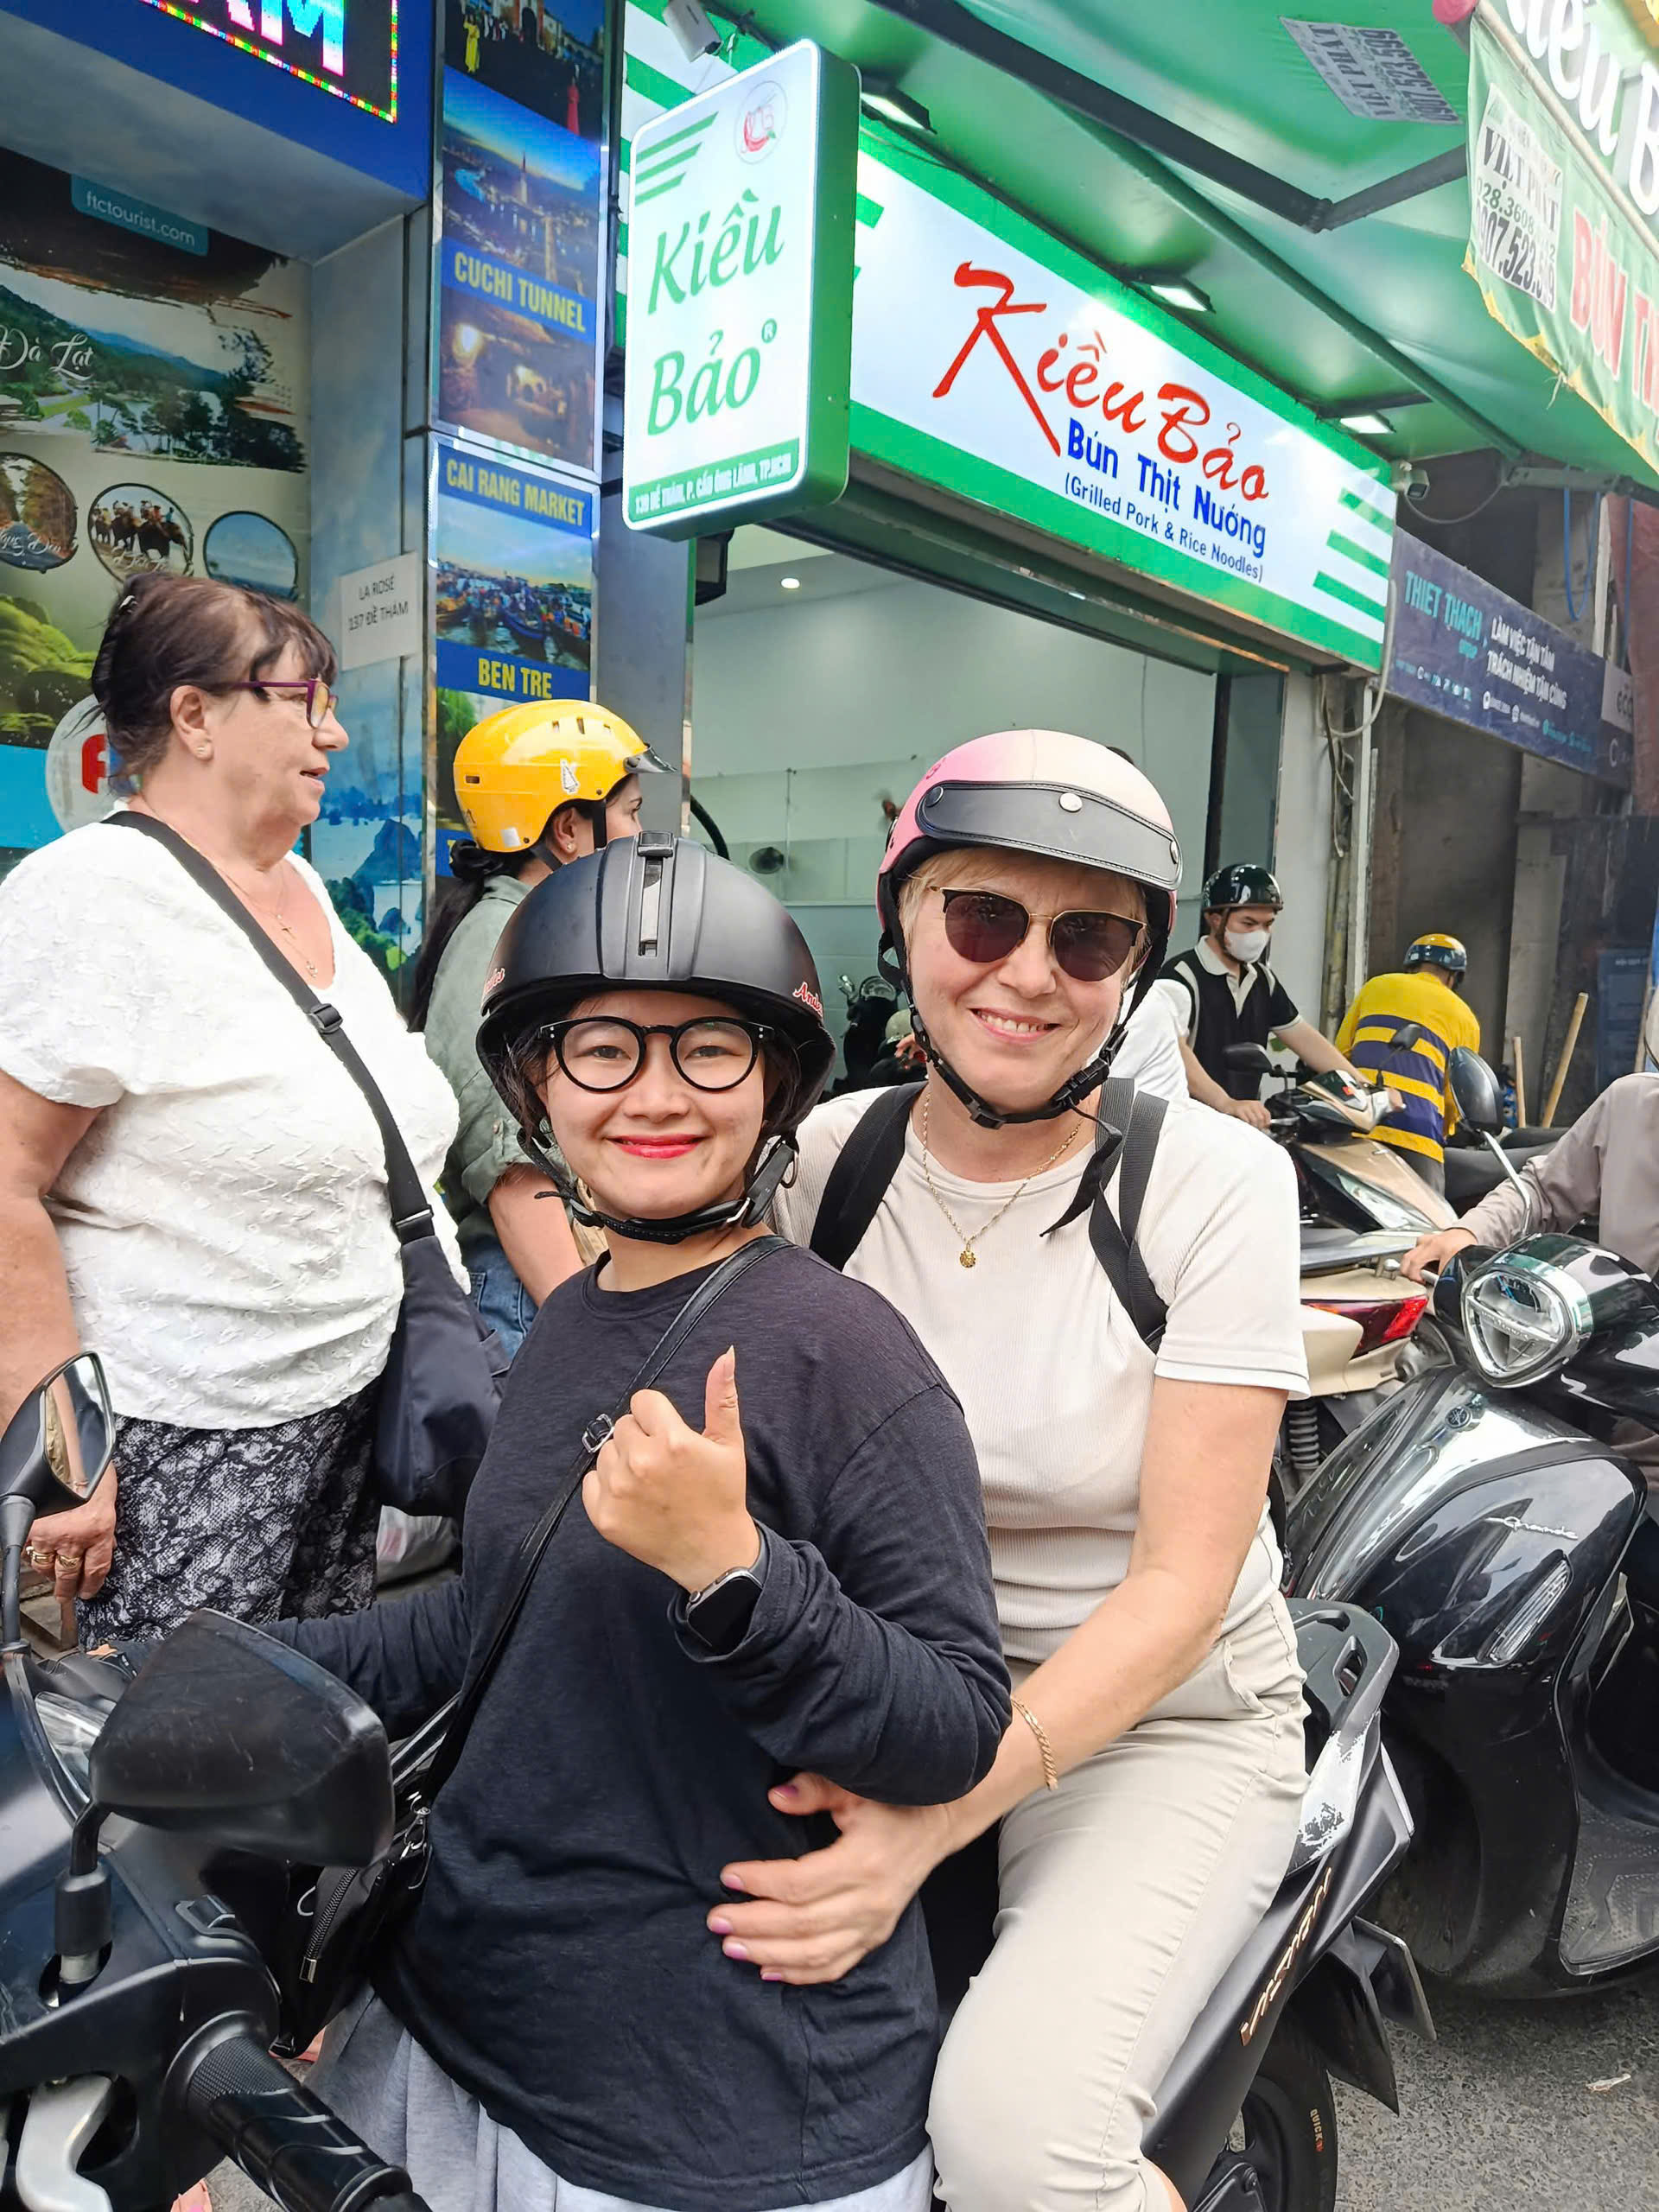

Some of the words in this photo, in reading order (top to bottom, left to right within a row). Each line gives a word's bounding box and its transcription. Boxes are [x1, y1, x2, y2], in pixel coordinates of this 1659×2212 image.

[86, 190, 196, 247] ftctourist.com
[648, 188, 785, 316] Kiều
[454, 251, 512, 302] CUCHI
[518, 278, 586, 334] TUNNEL
[49, 333, 95, 381] Lạt
[932, 261, 1147, 457] Kiều
[1156, 383, 1269, 501] Bảo
[447, 459, 474, 493] CAI
[478, 469, 520, 506] RANG
[524, 484, 585, 526] MARKET
[1067, 417, 1119, 480] Bún
[1137, 454, 1181, 514] Thịt
[1193, 485, 1267, 558] Nướng
[1065, 473, 1121, 517] (Grilled
[1127, 500, 1159, 534] Pork
[1165, 523, 1174, 542] &
[1180, 528, 1206, 556] Rice
[1211, 543, 1264, 584] Noodles)
[478, 658, 515, 693] BEN
[520, 667, 552, 700] TRE
[1310, 2108, 1323, 2141] QUICK
